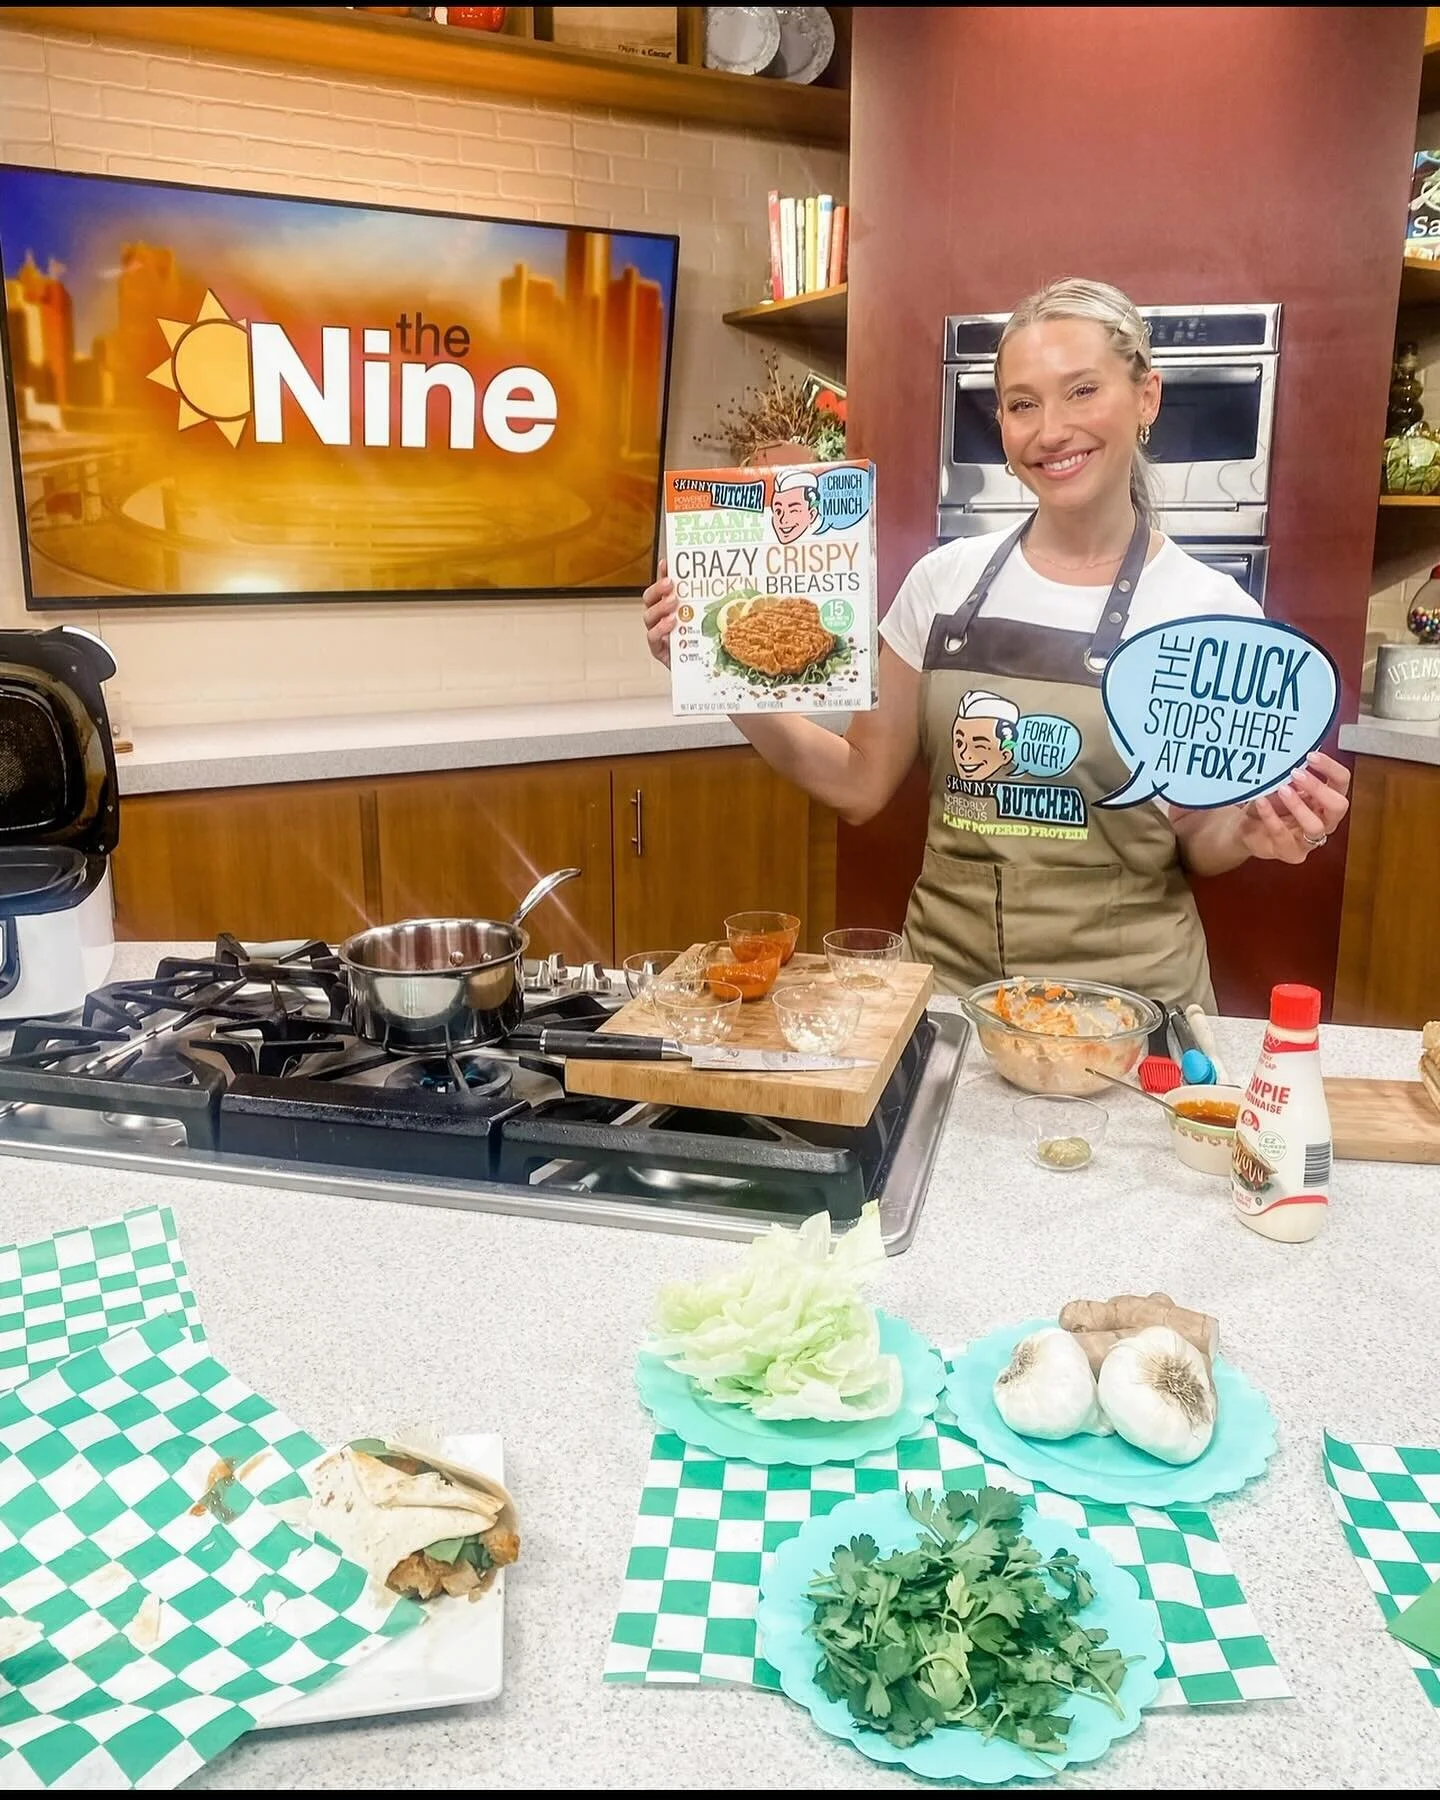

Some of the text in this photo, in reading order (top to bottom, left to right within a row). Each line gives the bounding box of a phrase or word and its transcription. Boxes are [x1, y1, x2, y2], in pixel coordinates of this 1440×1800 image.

[396, 312, 470, 357] the
[250, 322, 558, 453] Nine
[675, 479, 763, 509] SKINNY BUTCHER
[827, 474, 862, 490] CRUNCH
[674, 495, 709, 504] POWERED
[823, 497, 862, 515] MUNCH
[675, 511, 764, 531] PLANT
[675, 528, 764, 545] PROTEIN
[676, 542, 859, 579] CRAZY CRISPY
[676, 572, 860, 599] CHICK'N BREASTS
[683, 607, 689, 619] 8
[828, 601, 844, 616] 15
[1151, 633, 1310, 711] THE CLUCK
[1023, 720, 1071, 745] FORK IT
[1144, 698, 1297, 753] STOPS HERE
[1021, 742, 1066, 770] OVER!
[1155, 740, 1266, 785] AT FOX 2!
[947, 775, 1083, 822] SKINNY BUTCHER
[943, 813, 1088, 840] PLANT POWERED PROTEIN
[1249, 1073, 1291, 1104] WPIE
